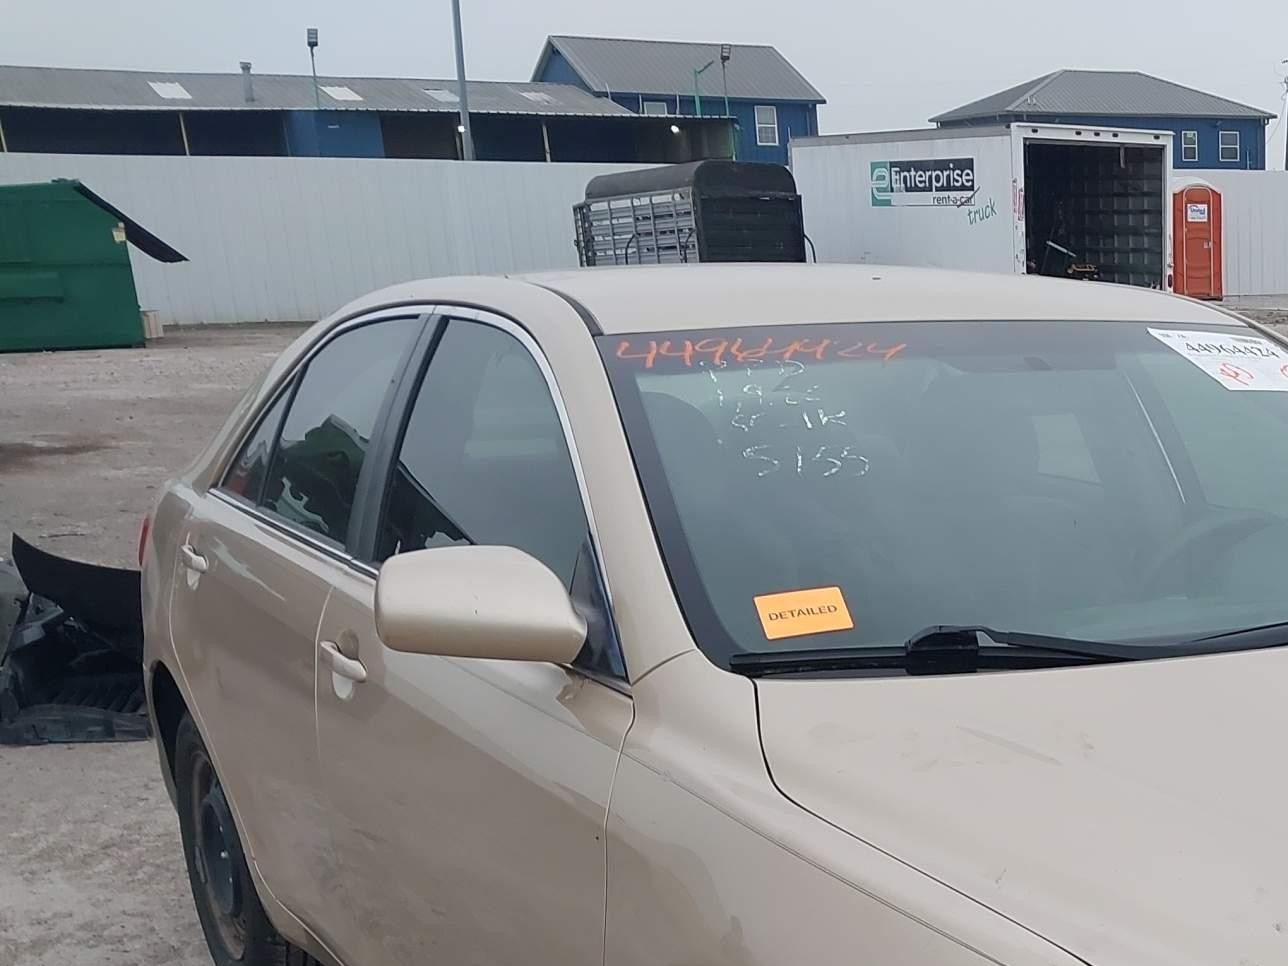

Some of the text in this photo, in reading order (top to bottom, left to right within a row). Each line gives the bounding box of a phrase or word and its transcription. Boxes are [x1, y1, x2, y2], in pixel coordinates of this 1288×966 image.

[890, 163, 974, 192] Enterprise
[967, 198, 998, 225] truck
[768, 604, 838, 621] DETAILED
